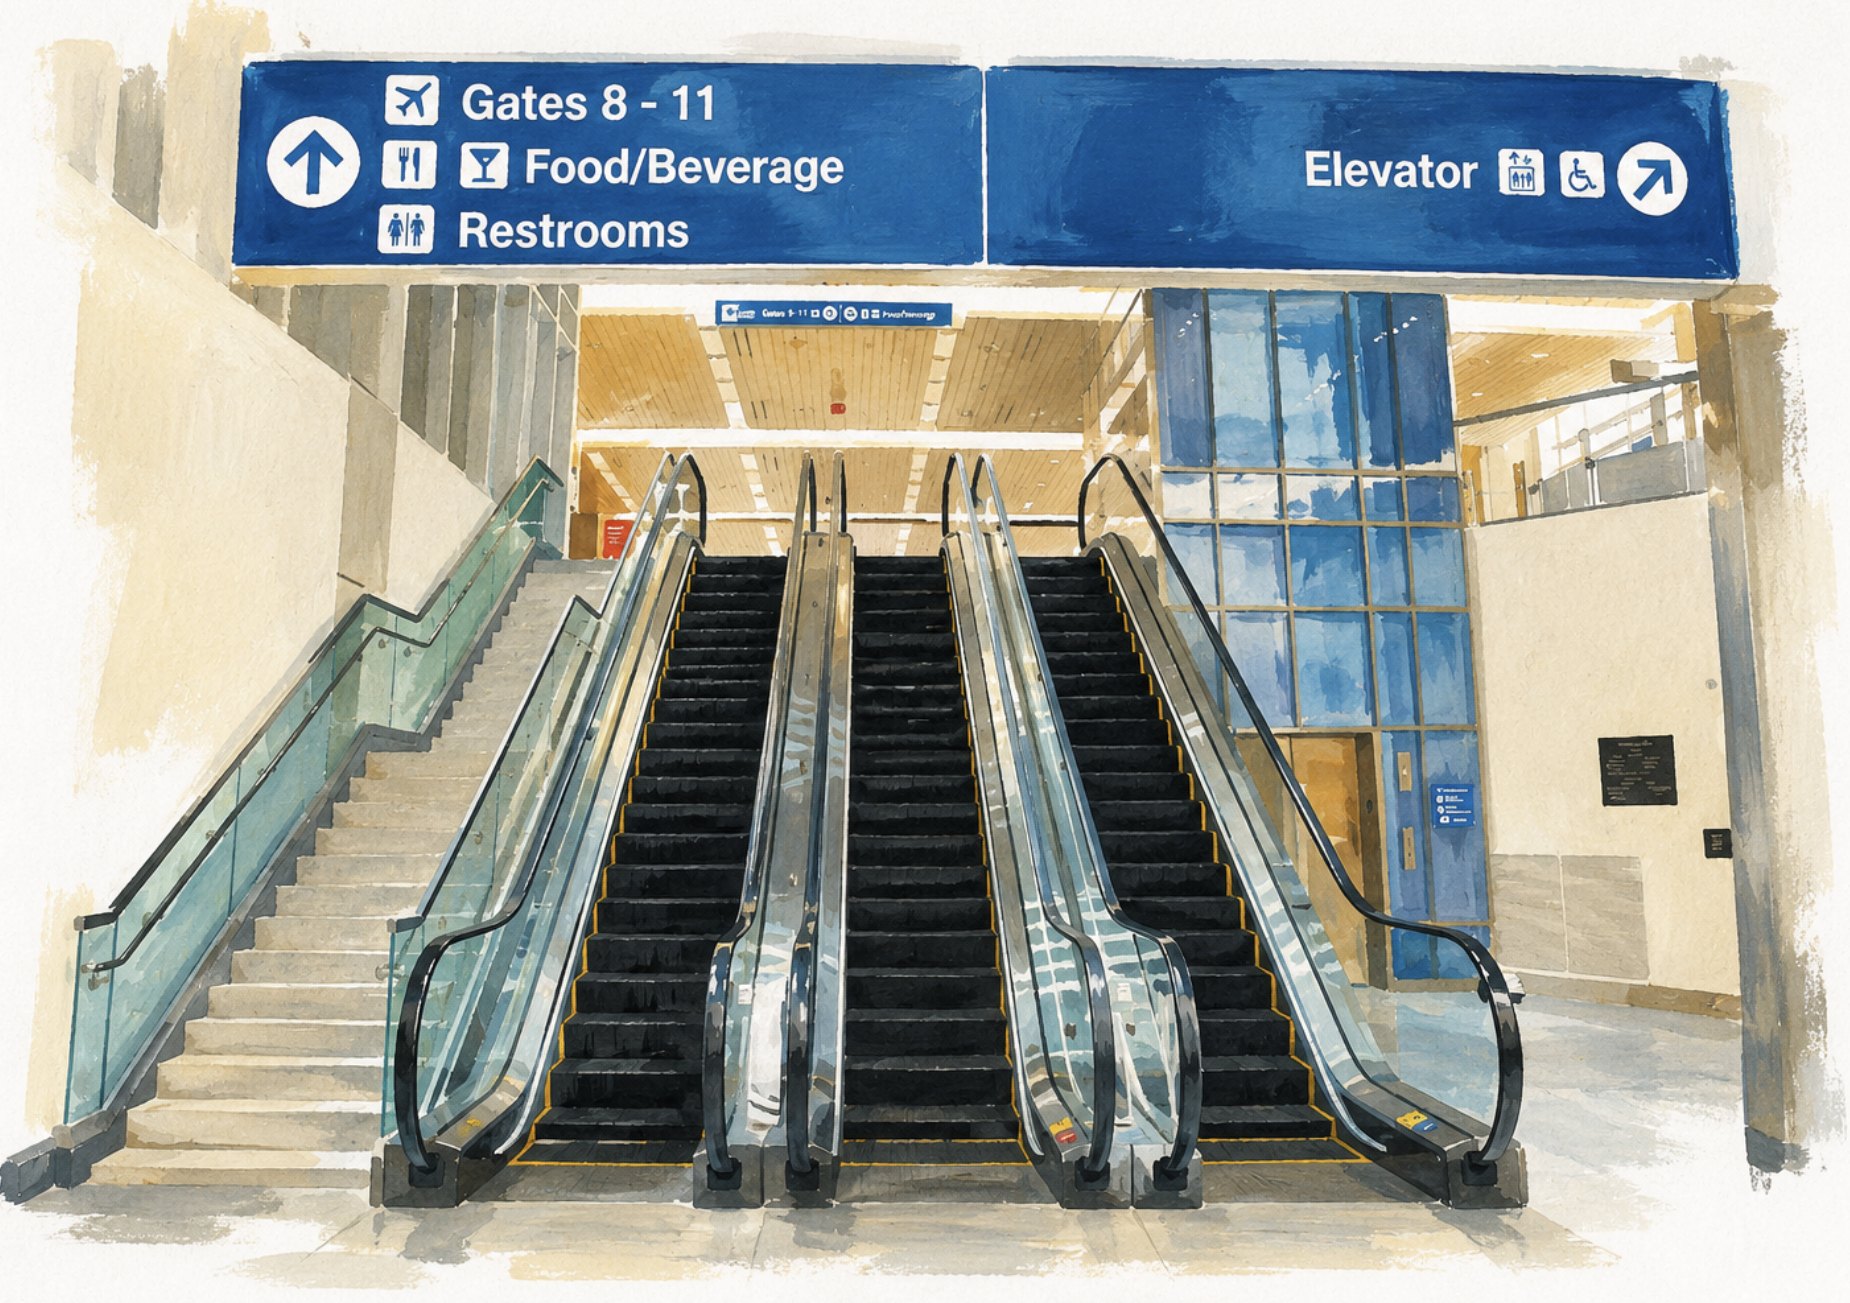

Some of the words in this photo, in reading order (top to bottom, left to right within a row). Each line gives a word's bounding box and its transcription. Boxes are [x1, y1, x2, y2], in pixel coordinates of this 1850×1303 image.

[462, 83, 588, 121] Gates
[602, 84, 627, 121] 8
[640, 101, 657, 109] -
[672, 84, 713, 121] 11
[526, 147, 844, 193] Food/Beverage
[1305, 150, 1479, 189] Elevator
[459, 211, 689, 249] Restrooms
